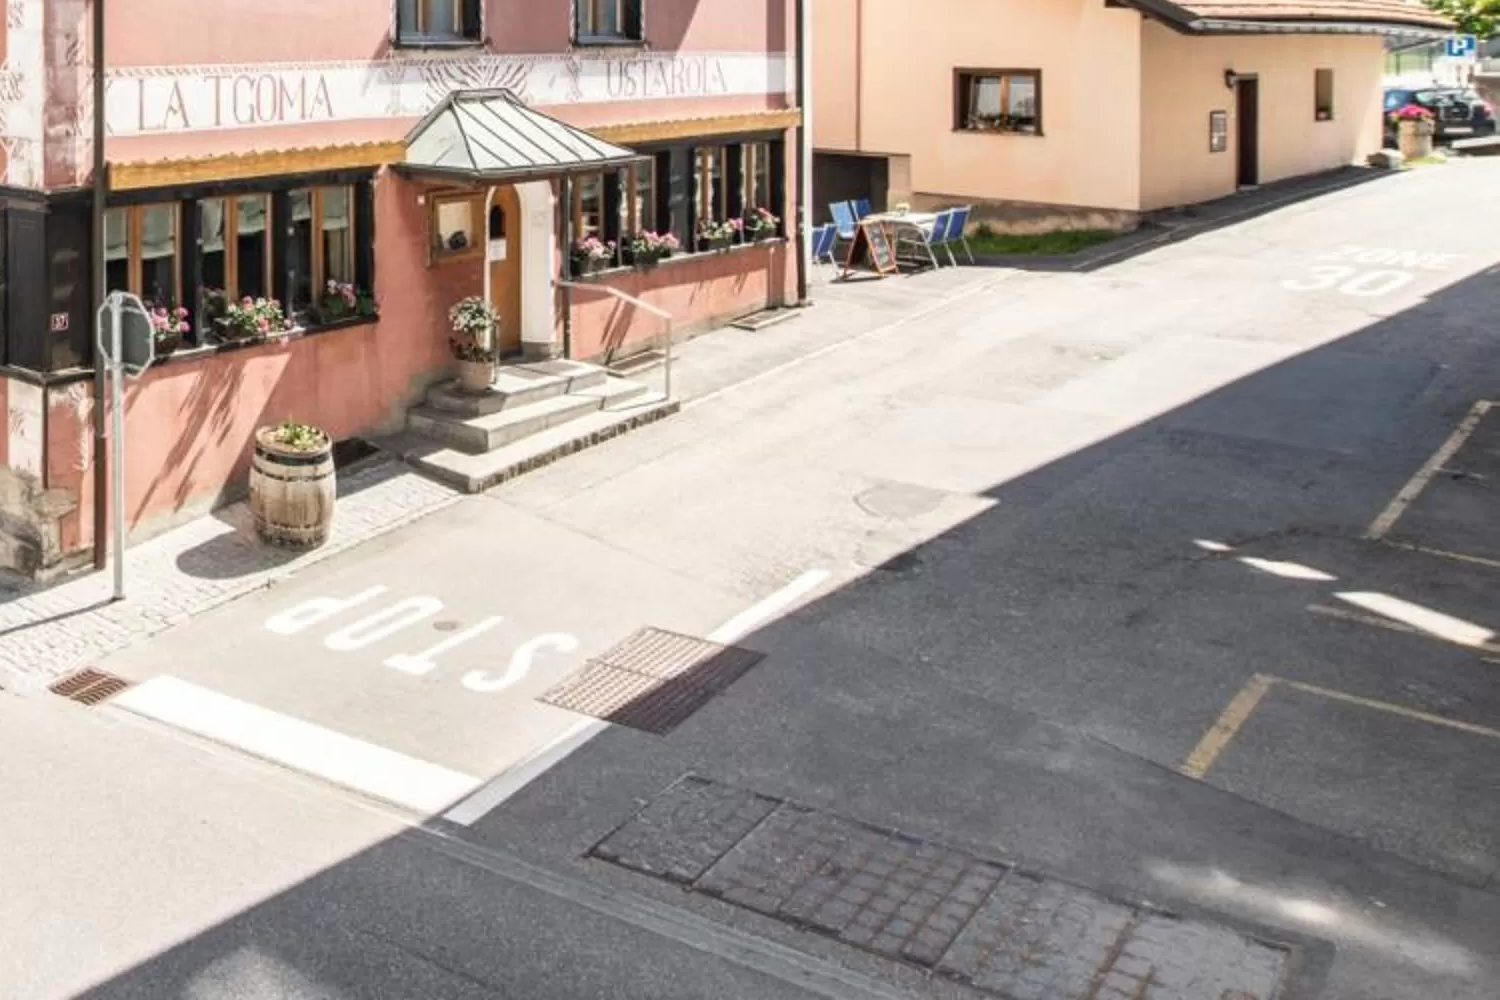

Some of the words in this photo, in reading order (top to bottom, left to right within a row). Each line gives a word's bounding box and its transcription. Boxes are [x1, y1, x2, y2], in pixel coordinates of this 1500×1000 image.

[137, 77, 191, 131] LA
[203, 73, 334, 127] TGOMA
[1280, 263, 1416, 296] 30
[265, 585, 579, 693] STOP
